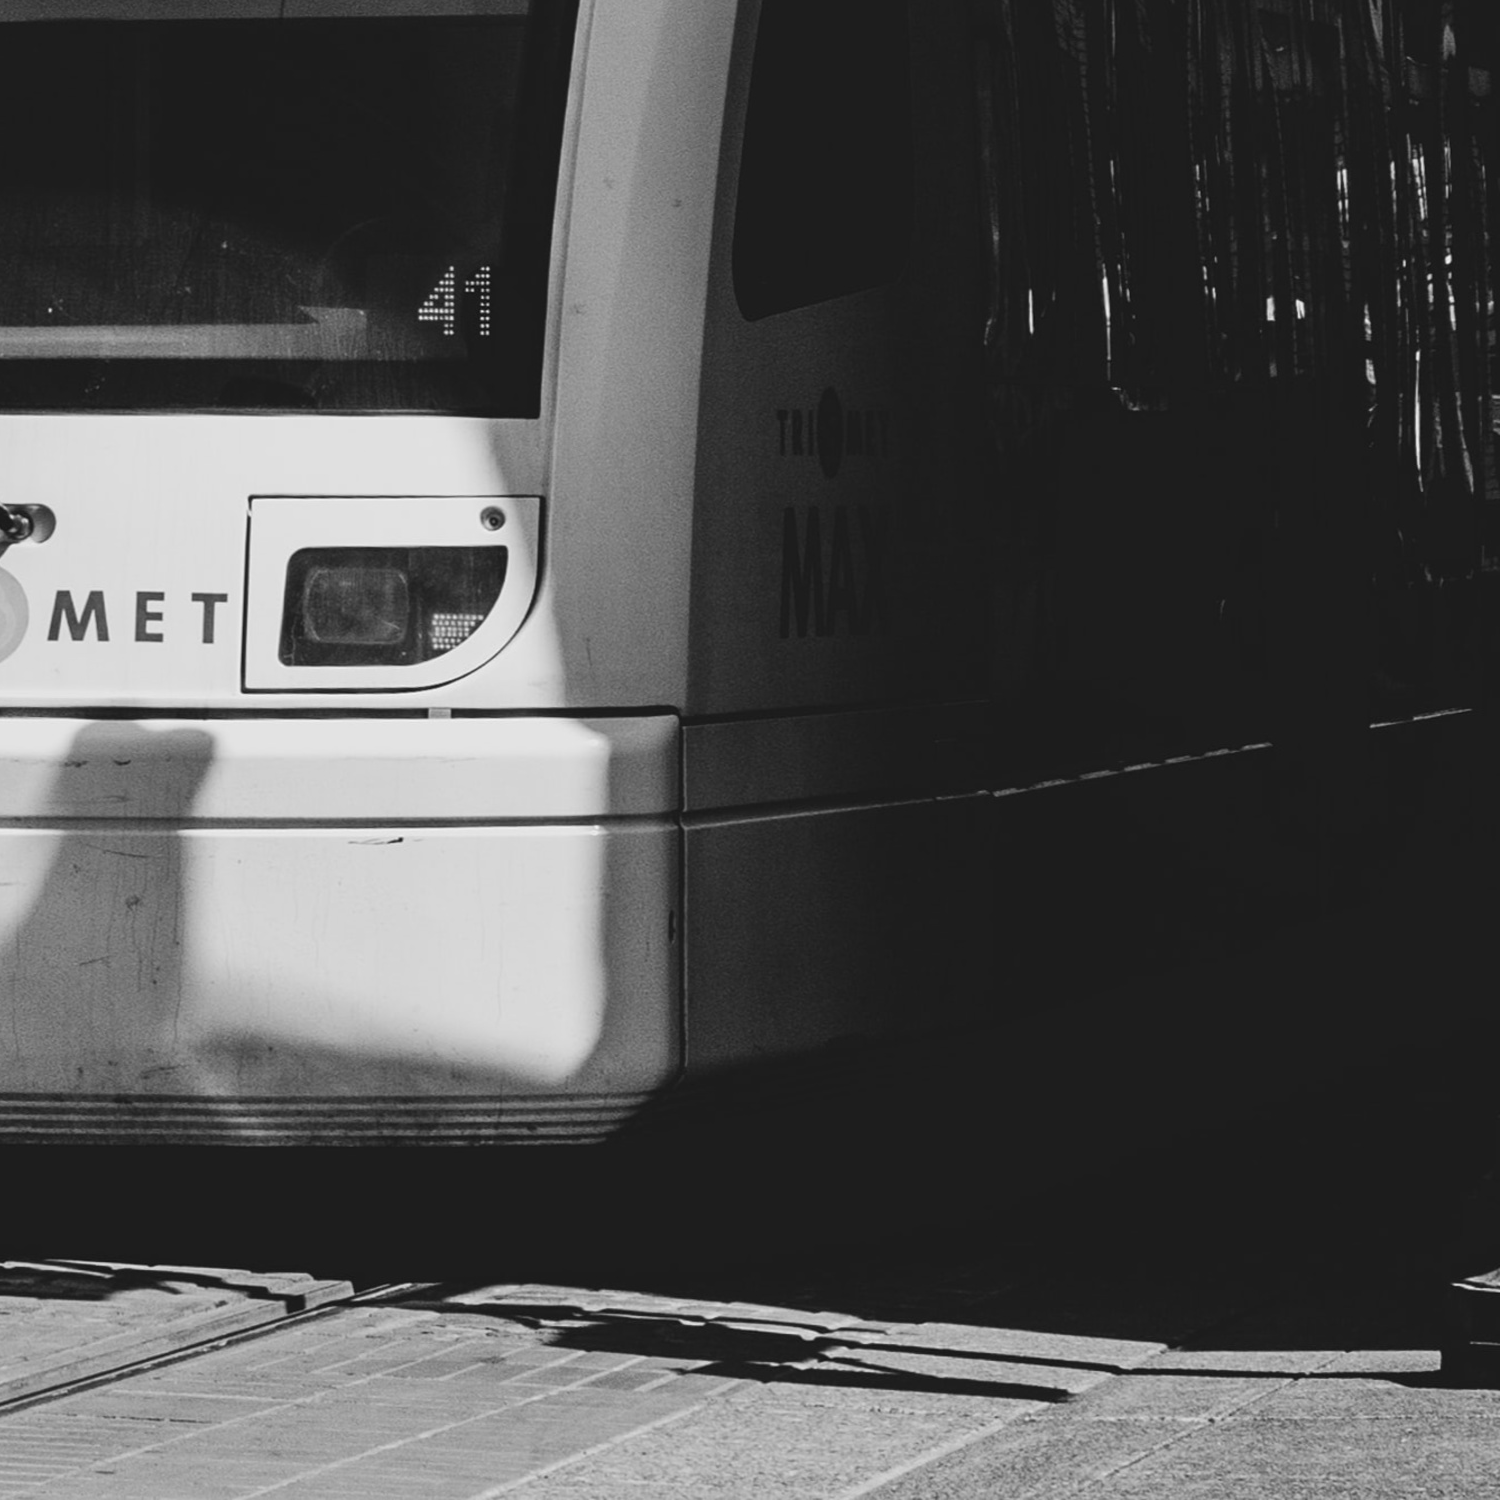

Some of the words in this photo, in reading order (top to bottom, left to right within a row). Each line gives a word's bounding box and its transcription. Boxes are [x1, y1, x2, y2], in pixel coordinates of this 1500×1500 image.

[417, 265, 490, 336] 41
[776, 409, 814, 456] TRI
[779, 505, 892, 639] MAX
[46, 589, 229, 644] MET
